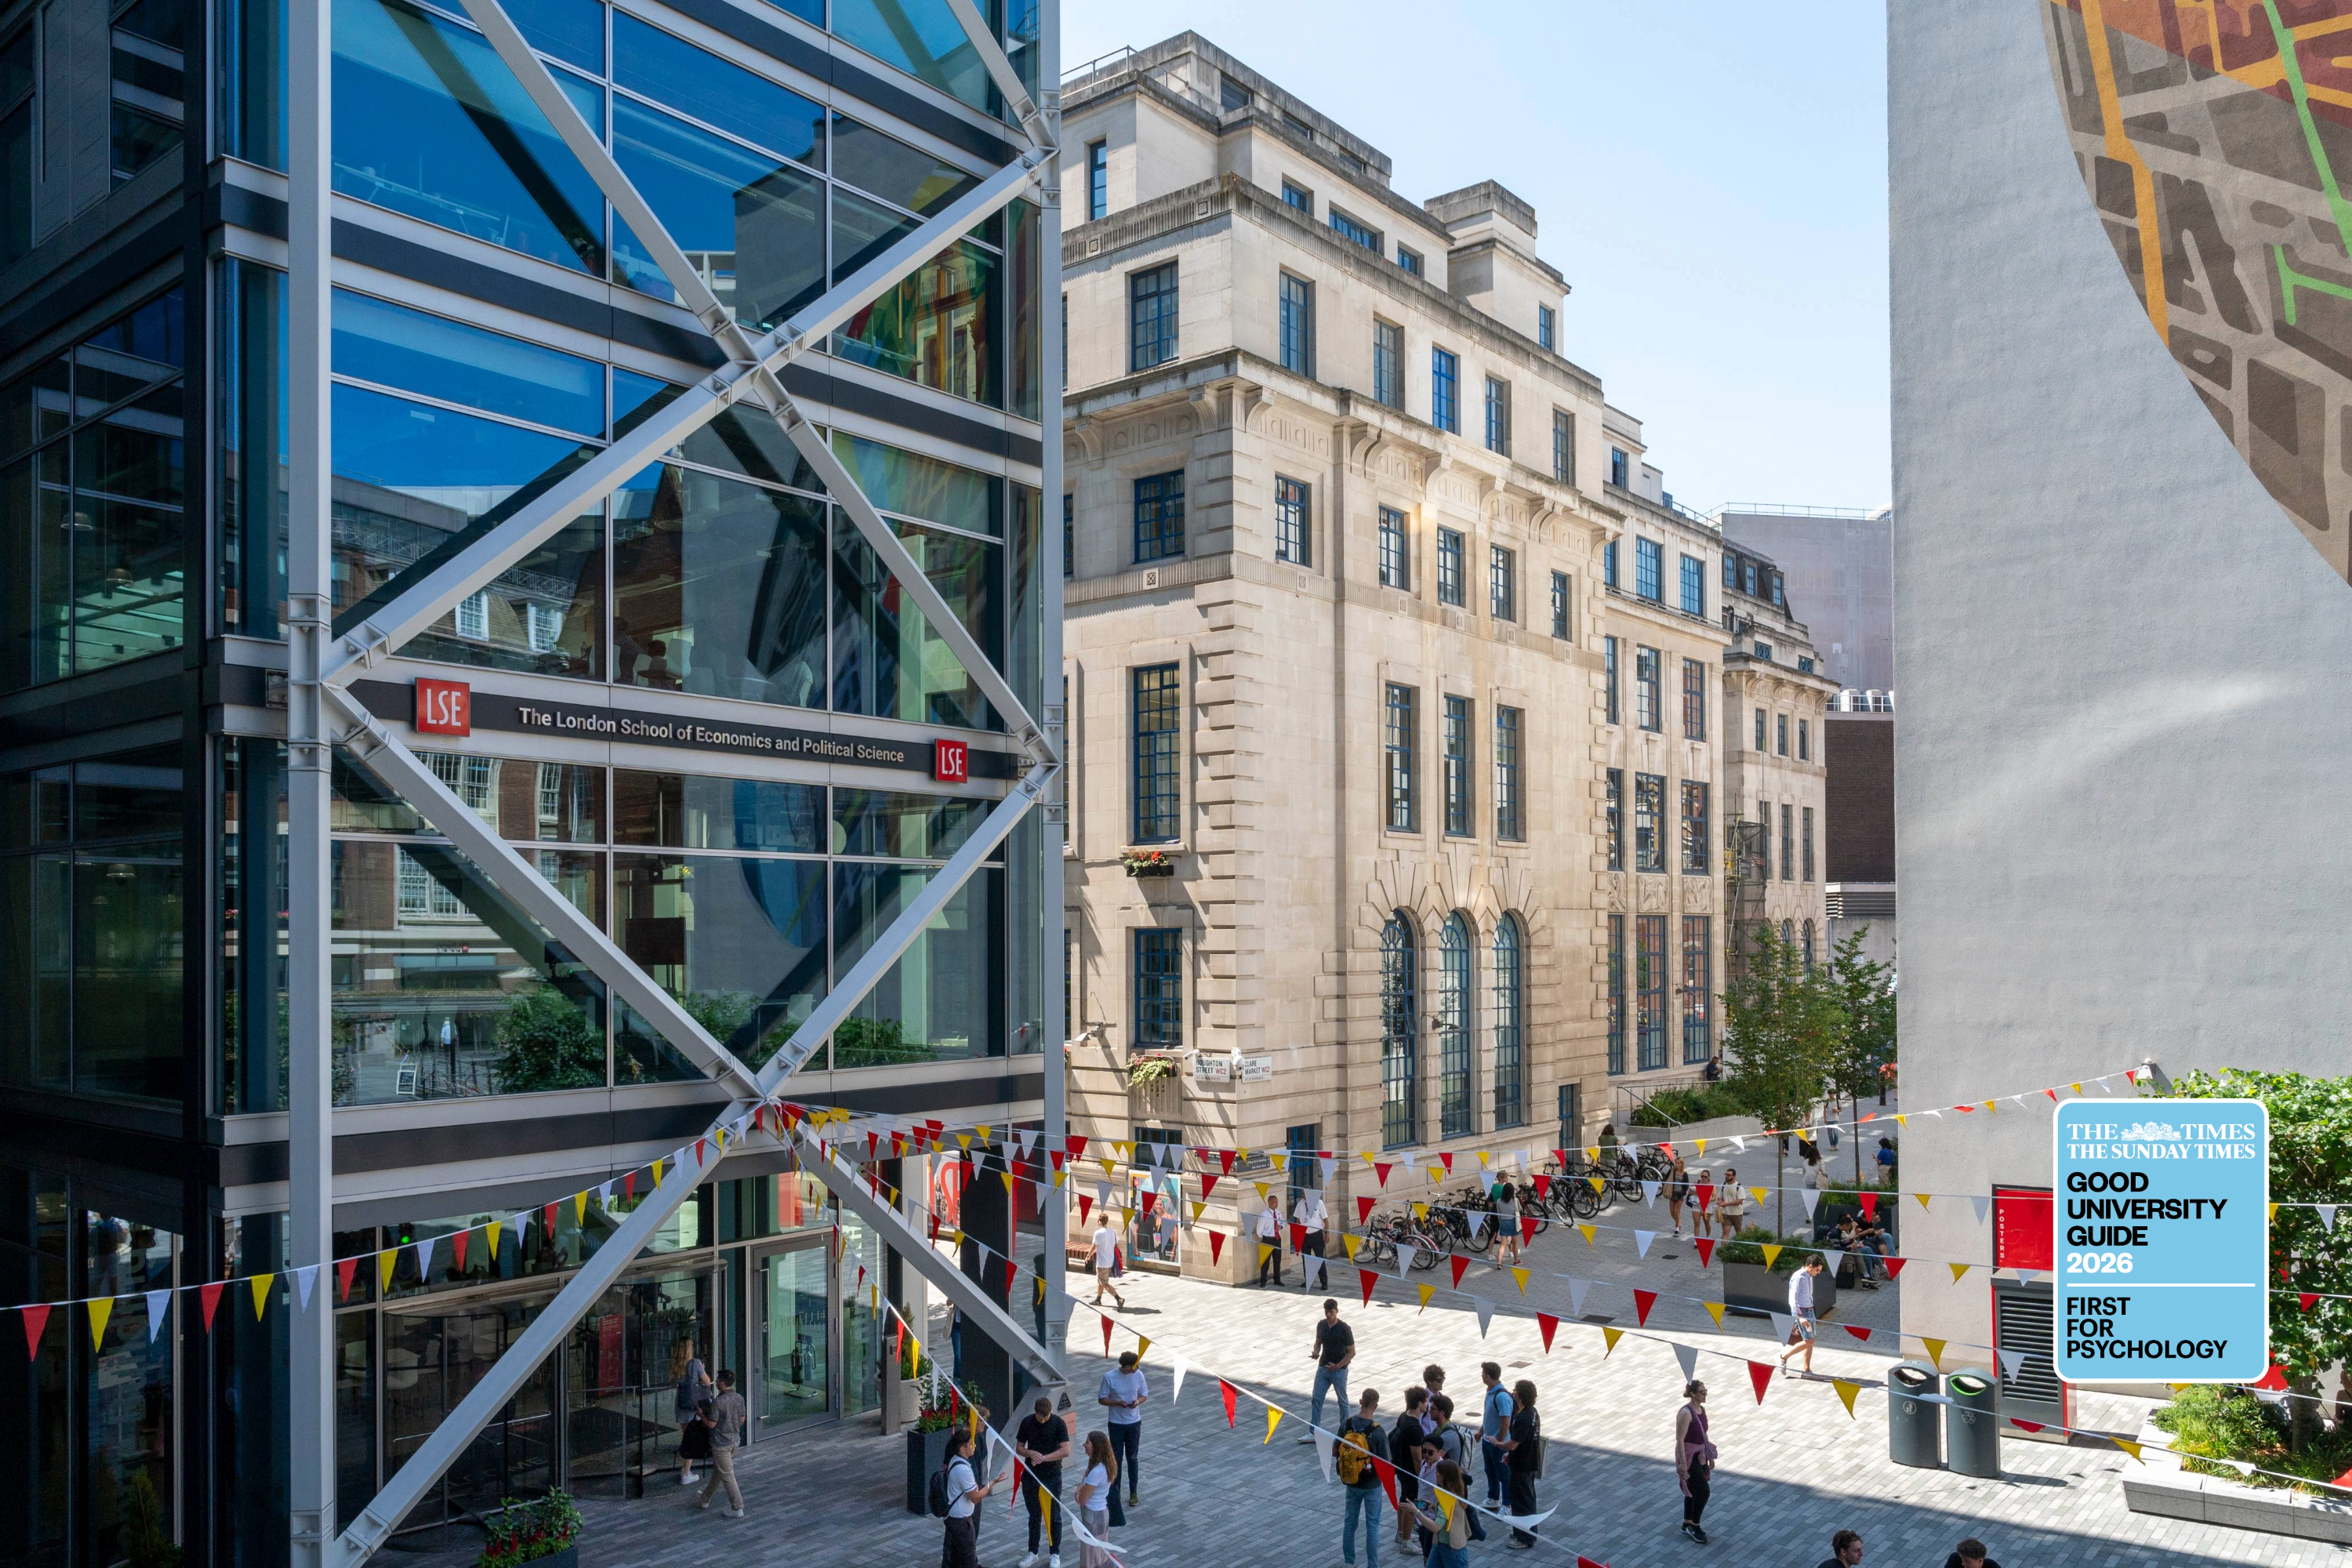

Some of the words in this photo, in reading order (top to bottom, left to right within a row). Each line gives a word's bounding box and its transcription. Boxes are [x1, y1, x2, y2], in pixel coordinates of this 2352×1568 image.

[426, 688, 462, 727] LSE
[519, 707, 552, 726] The
[557, 711, 616, 733] London
[620, 718, 673, 739] School
[677, 724, 692, 741] of
[696, 727, 772, 749] Economics
[775, 737, 800, 751] and
[803, 739, 854, 757] Political
[857, 744, 905, 763] Science
[942, 746, 963, 776] LSE
